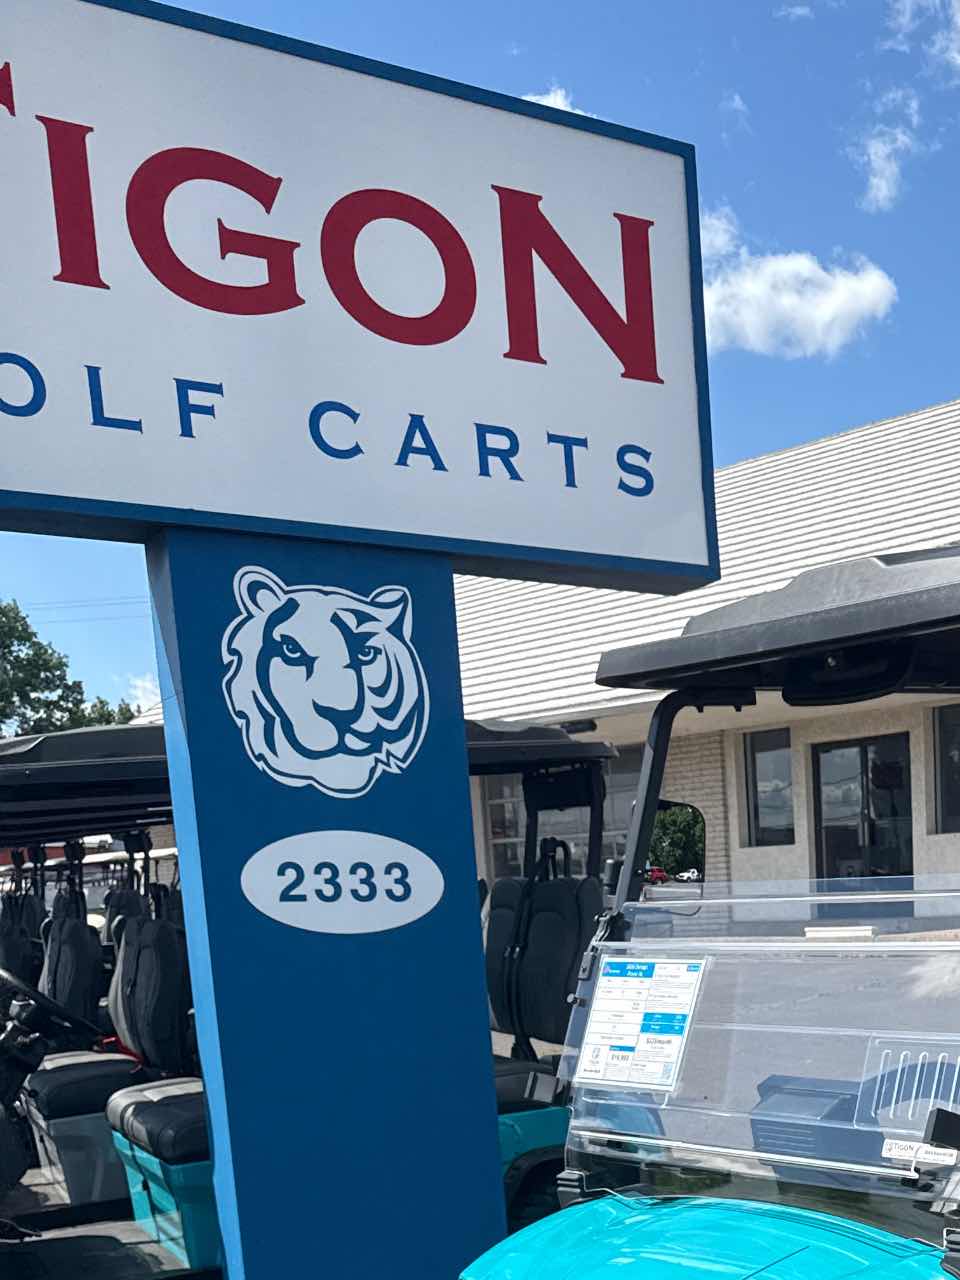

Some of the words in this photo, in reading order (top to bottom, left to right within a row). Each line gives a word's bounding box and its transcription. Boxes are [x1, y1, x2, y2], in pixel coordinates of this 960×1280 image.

[0, 61, 664, 385] IGON
[308, 401, 655, 497] CARTS
[276, 861, 412, 902] 2333
